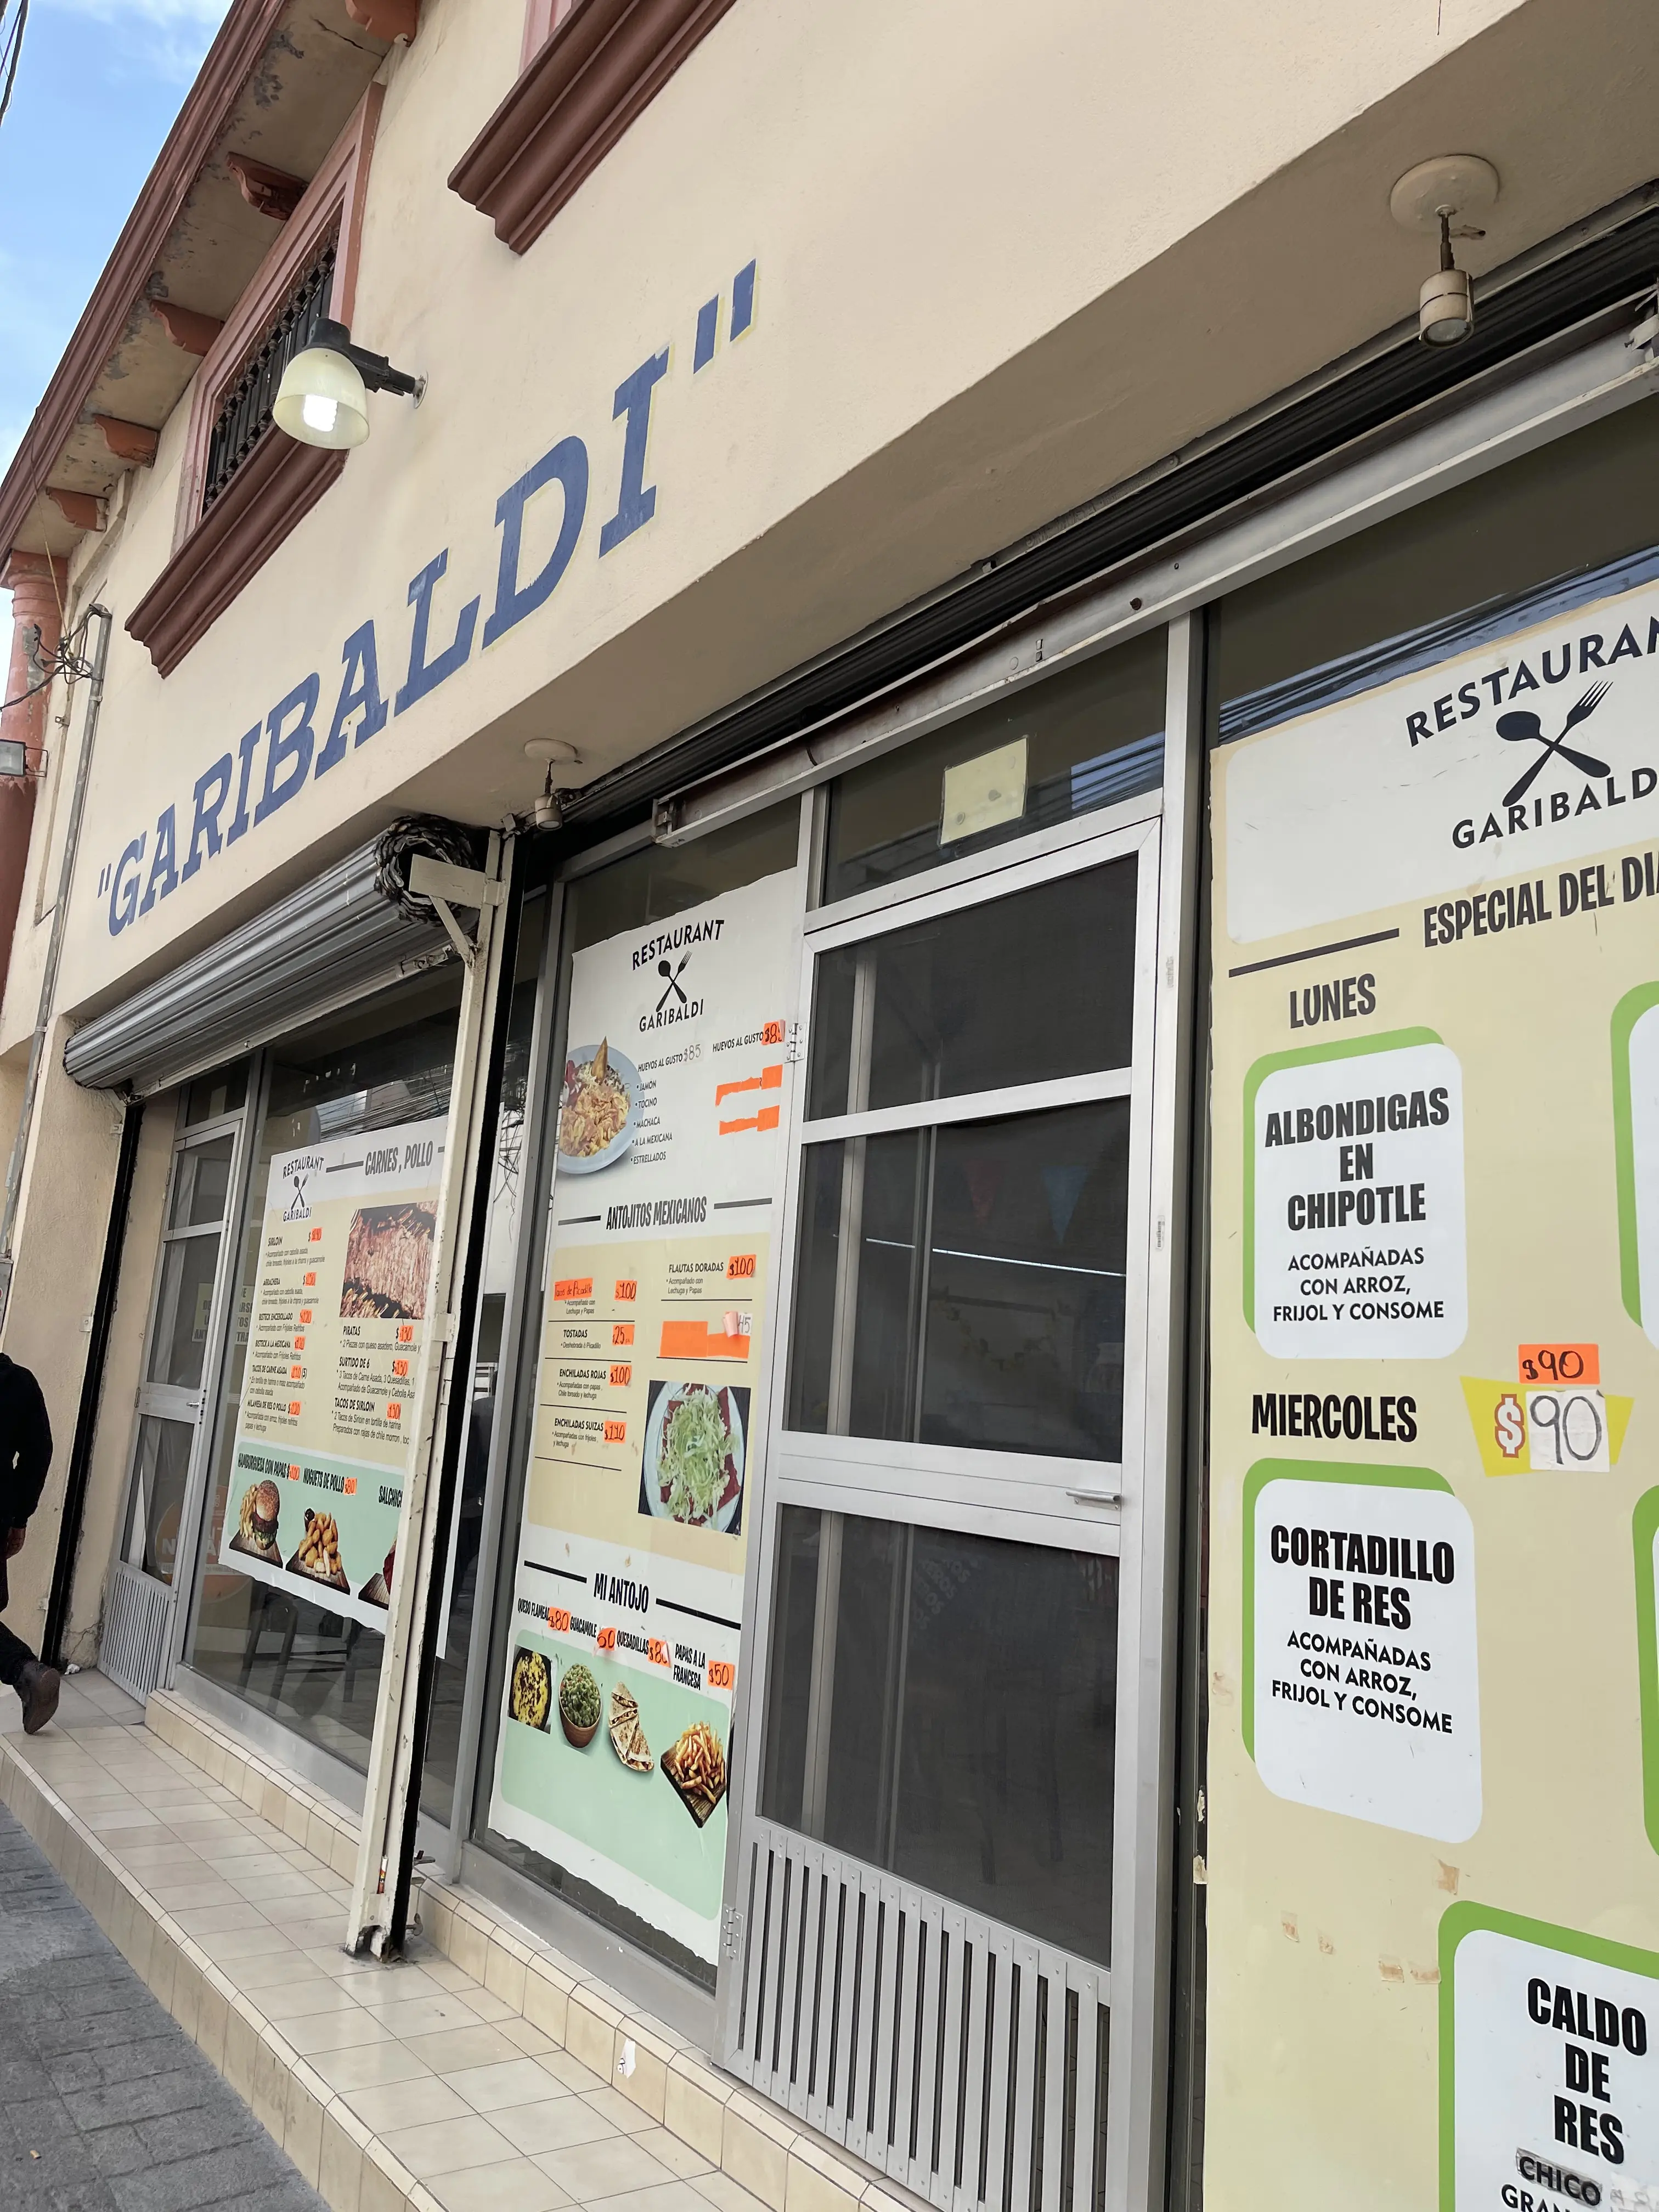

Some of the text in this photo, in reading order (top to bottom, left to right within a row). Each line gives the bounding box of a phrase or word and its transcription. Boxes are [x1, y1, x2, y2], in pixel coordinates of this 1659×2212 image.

[1424, 851, 1659, 948] ESPECIAL DEL DI
[632, 919, 725, 971] RESTAURANT
[1290, 973, 1376, 1029] LUNES
[639, 998, 704, 1032] GARIBALDI
[712, 1039, 735, 1053] HUEVOS
[735, 1037, 743, 1050] AL
[744, 1031, 764, 1046] GUSTO
[637, 1043, 702, 1073] HUEVOS AL GUSTO $85
[638, 1097, 657, 1109] TOCINO
[636, 1116, 661, 1128] MACHACA
[1265, 1087, 1450, 1148] ALBONDIGAS
[634, 1132, 673, 1147] A LA MEXICANA
[283, 1155, 324, 1179] RESTAURANT
[404, 1141, 433, 1170] POLLO
[633, 1151, 667, 1165] ESTRELLADOS
[1339, 1142, 1374, 1182] EN
[283, 1207, 312, 1222] GARIBALDI
[606, 1196, 707, 1231] ANTOJITOS MEXICANOS
[1287, 1183, 1426, 1231] CHIPOTLE
[268, 1236, 283, 1246] SIRLOIN
[669, 1257, 754, 1276] FLAUTAS DORADAS $100
[1287, 1246, 1424, 1272] ACOMPAÑADAS
[567, 1286, 572, 1295] de
[614, 1282, 637, 1300] $100
[668, 1286, 685, 1295] Lechuga
[1300, 1275, 1411, 1296] CON ARROZ,
[1273, 1301, 1444, 1322] FRIJOL Y CONSOME
[343, 1326, 360, 1336] PIRATAS
[563, 1329, 588, 1338] TOSTADAS
[252, 1364, 262, 1373] TACOS
[267, 1365, 277, 1374] CARNE
[277, 1366, 287, 1374] ASADA
[339, 1357, 359, 1368] SURTIDO
[359, 1358, 366, 1368] DE
[366, 1359, 370, 1369] 6
[559, 1366, 630, 1385] ENCHILADAS ROJAS $100
[1522, 1350, 1584, 1381] $90
[262, 1401, 267, 1409] DE
[276, 1403, 286, 1412] POLLO
[335, 1397, 349, 1409] TACOS
[349, 1399, 356, 1410] DE
[356, 1400, 375, 1412] SIRLOIN
[554, 1418, 625, 1441] ENCHILADAS SUIZAS $110
[1251, 1393, 1418, 1443] MIERCOLES
[1494, 1392, 1604, 1465] $90
[237, 1453, 265, 1472] HAMBURGUESA
[265, 1458, 274, 1475] CON
[274, 1459, 286, 1479] PAPAS
[303, 1467, 323, 1488] NUGUETS
[323, 1472, 330, 1489] DE
[330, 1474, 345, 1493] POLLO
[1270, 1524, 1455, 1584] CORTADILLO
[593, 1573, 649, 1613] MI ANTOJO
[1308, 1576, 1412, 1630] DE RES
[517, 1598, 531, 1615] QUESO
[549, 1610, 569, 1631] $80
[570, 1616, 597, 1639] GUACAMOLE
[617, 1630, 650, 1656] QUESADILLAS
[674, 1643, 692, 1663] PAPAS
[692, 1648, 697, 1665] A
[698, 1651, 706, 1669] LA
[709, 1664, 730, 1686] $50
[1286, 1630, 1431, 1671] ACOMPAÑADAS
[673, 1667, 701, 1691] FRANCESA
[1300, 1658, 1417, 1701] CON ARROZ,
[1271, 1679, 1453, 1734] FRIJOL Y CONSOME
[1527, 1977, 1647, 2056] CALDO
[1565, 2042, 1611, 2104] DE
[1553, 2094, 1624, 2165] RES
[1519, 2156, 1601, 2207] CHICO
